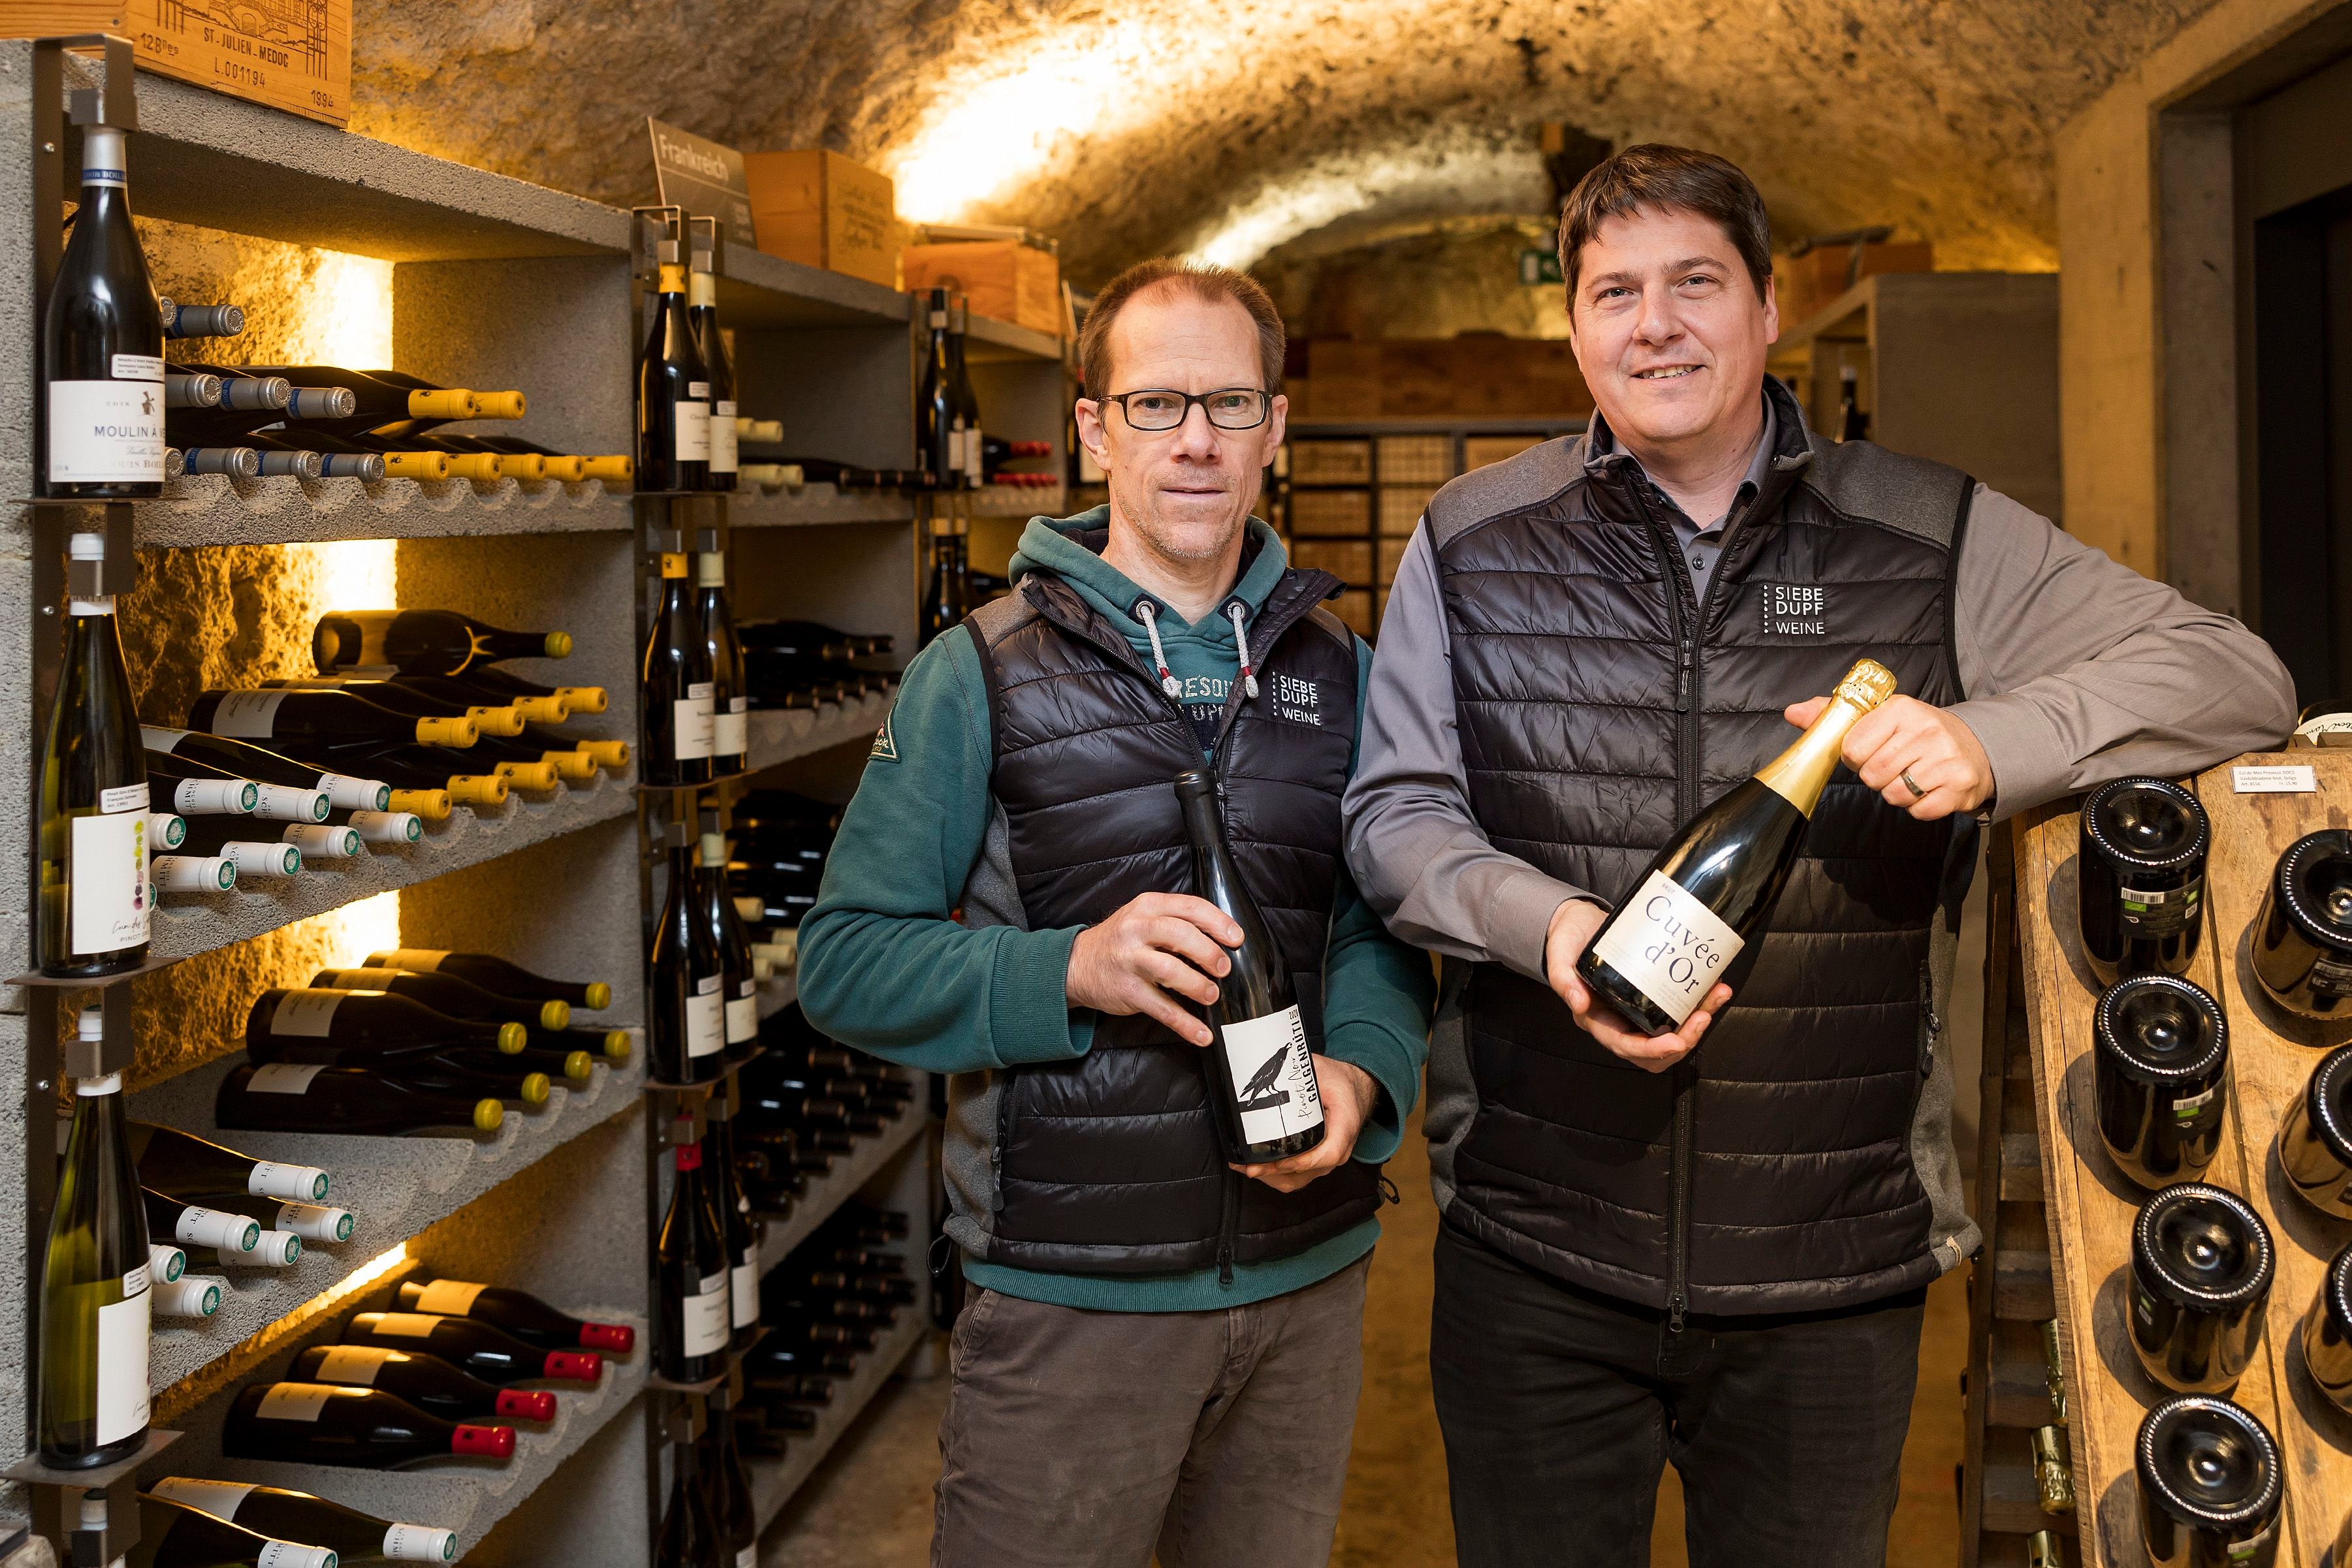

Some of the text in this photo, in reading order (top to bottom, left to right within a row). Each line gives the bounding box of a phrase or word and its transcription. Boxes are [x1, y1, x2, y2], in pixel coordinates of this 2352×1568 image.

[215, 57, 265, 87] L.001194
[311, 90, 334, 108] 1994
[658, 133, 729, 182] Frankreich
[95, 426, 148, 437] MOULIN
[1775, 586, 1823, 601] SIEBE
[1776, 601, 1824, 615] DUPF
[1776, 621, 1825, 635] WEINE
[1280, 675, 1317, 696] SIEBE
[1281, 688, 1318, 708] DUPF
[1282, 707, 1321, 725] WEINE
[1661, 883, 1675, 894] BRUT
[1645, 895, 1721, 968] Cuvée
[1644, 942, 1699, 994] d'Or
[1292, 1020, 1317, 1103] GALGENRÜTI
